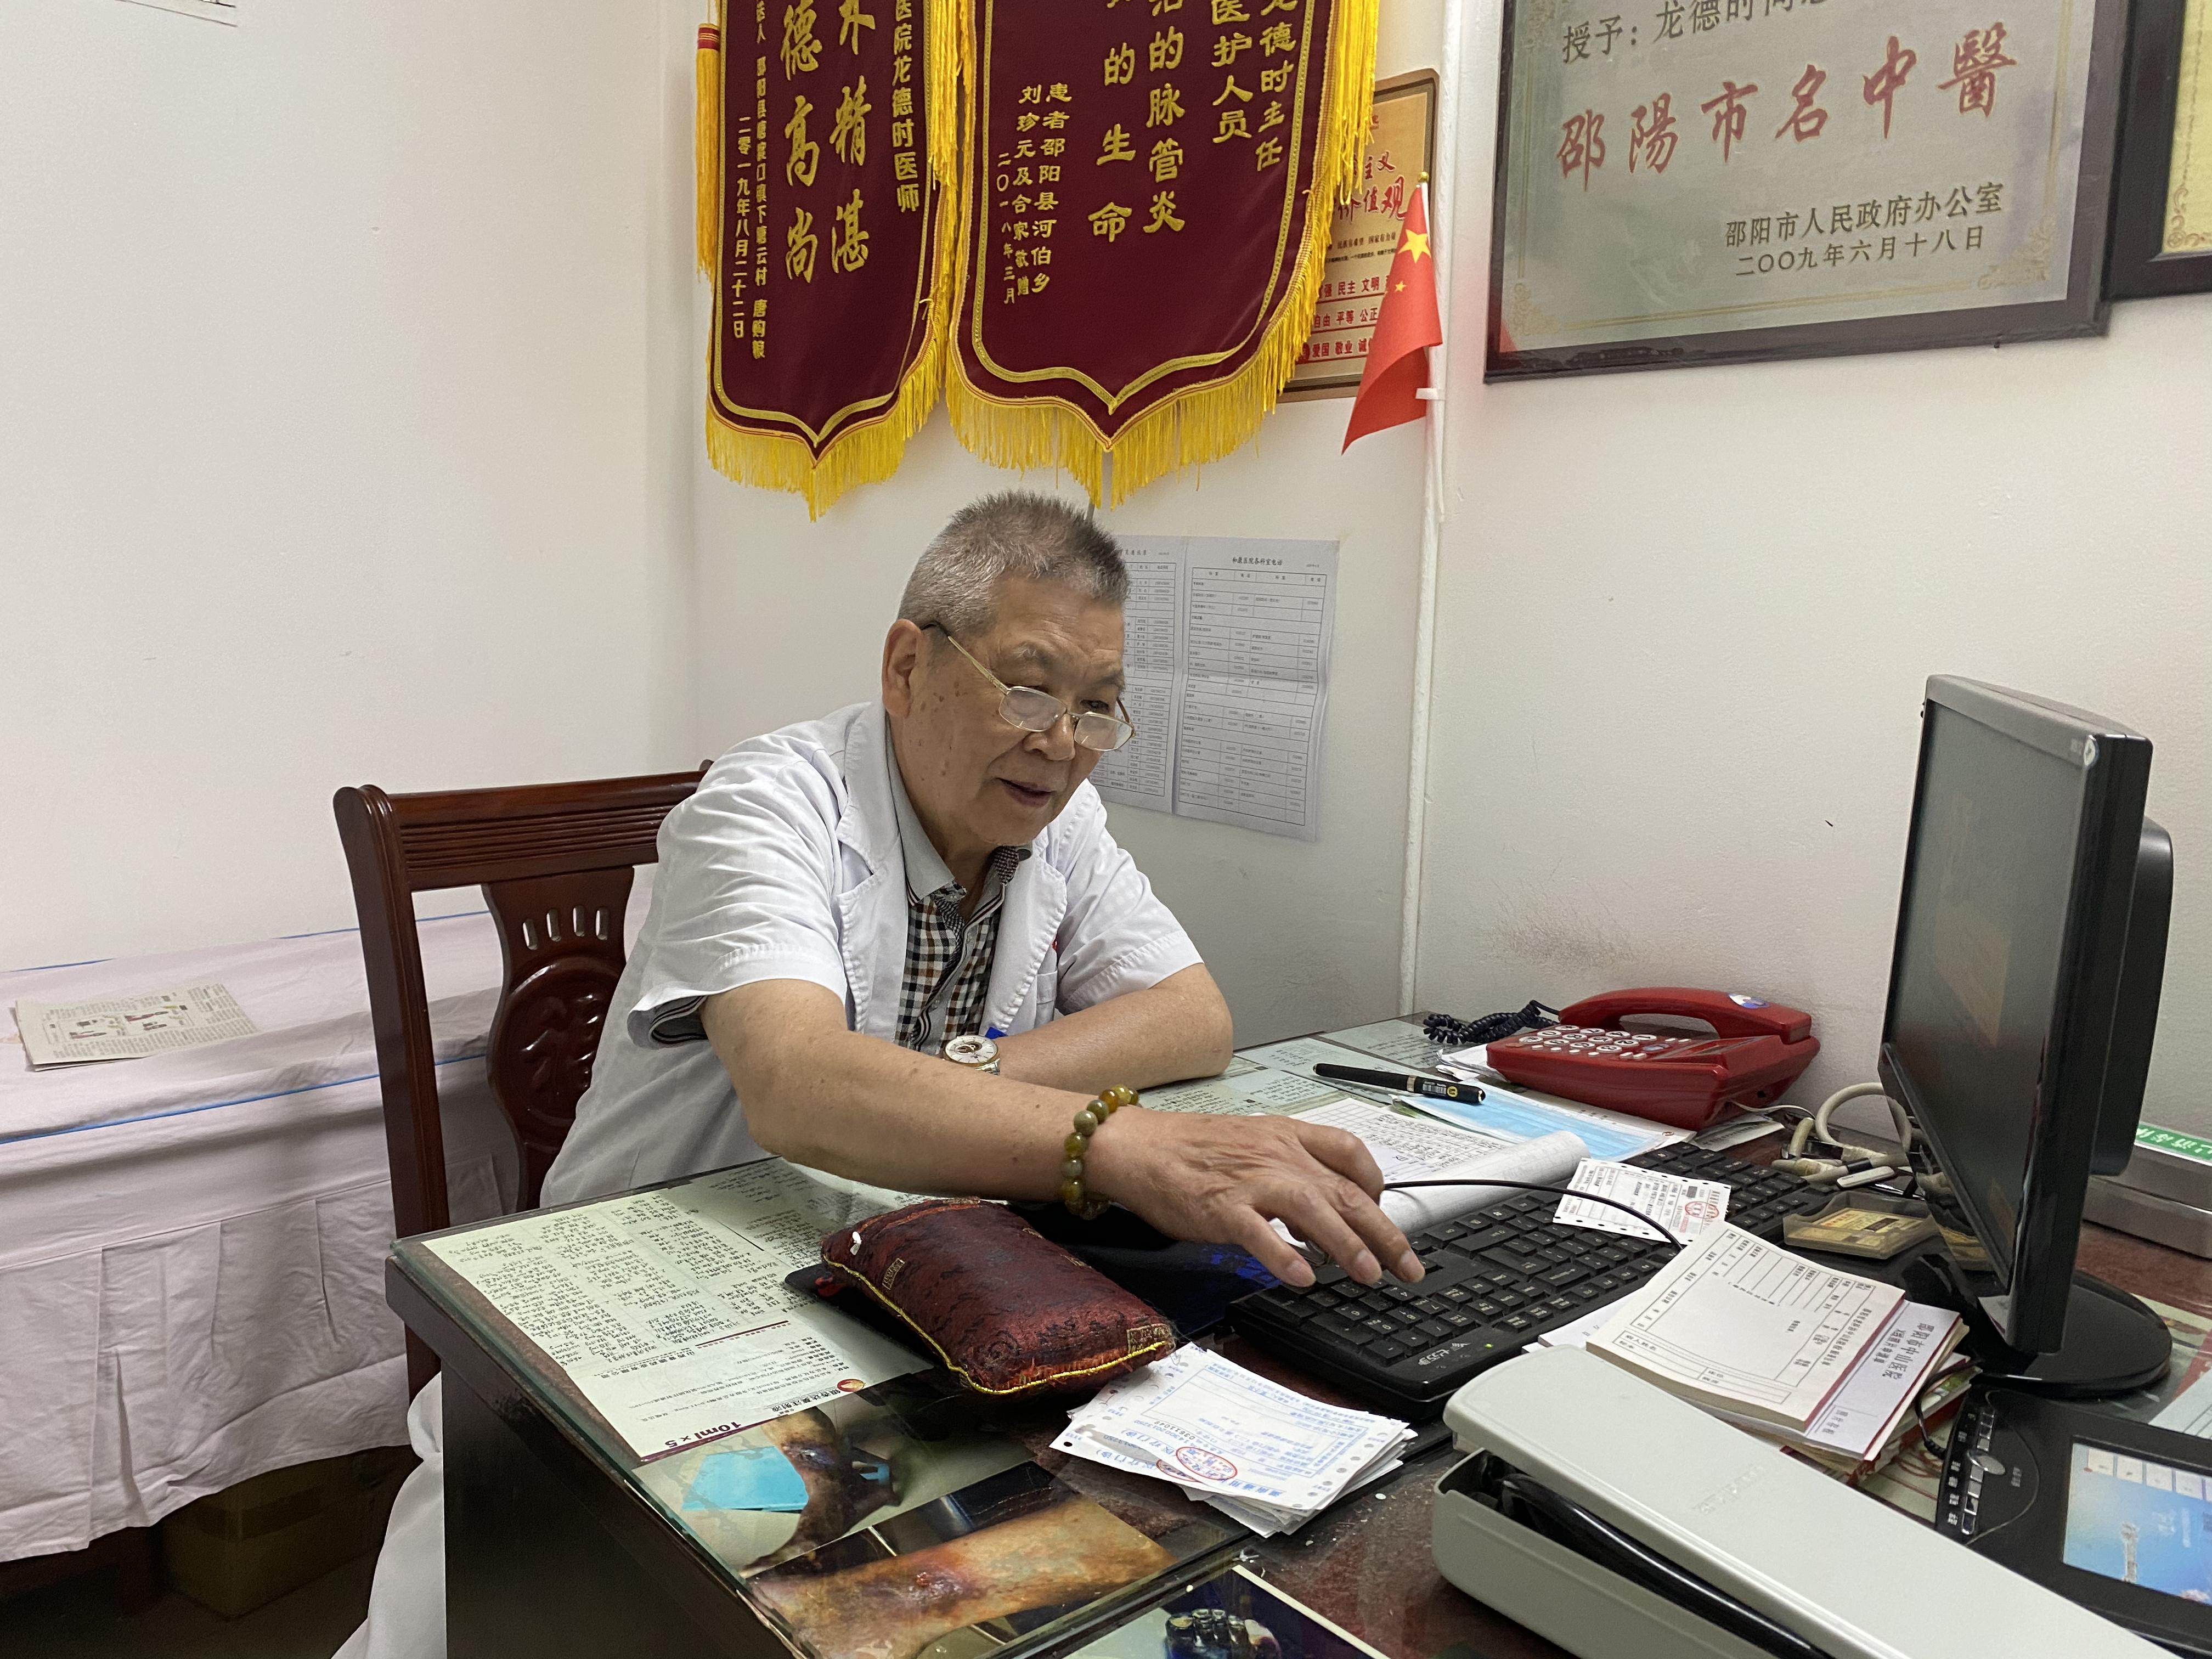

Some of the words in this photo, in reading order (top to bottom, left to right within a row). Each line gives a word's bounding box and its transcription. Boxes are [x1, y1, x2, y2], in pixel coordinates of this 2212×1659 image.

[1087, 0, 1136, 242] 的生命
[1353, 150, 1396, 180] 主义
[1031, 82, 1072, 293] 患者邵阳县河伯乡
[732, 116, 751, 339] 二零一九年八月二十二日
[1725, 182, 2003, 249] 邵阳市人民政府办公室
[1338, 280, 1356, 296] 民主
[1361, 276, 1380, 292] 文明
[1336, 310, 1355, 326] 平等
[664, 1440, 678, 1448] 5
[693, 1421, 742, 1440] 10ml
